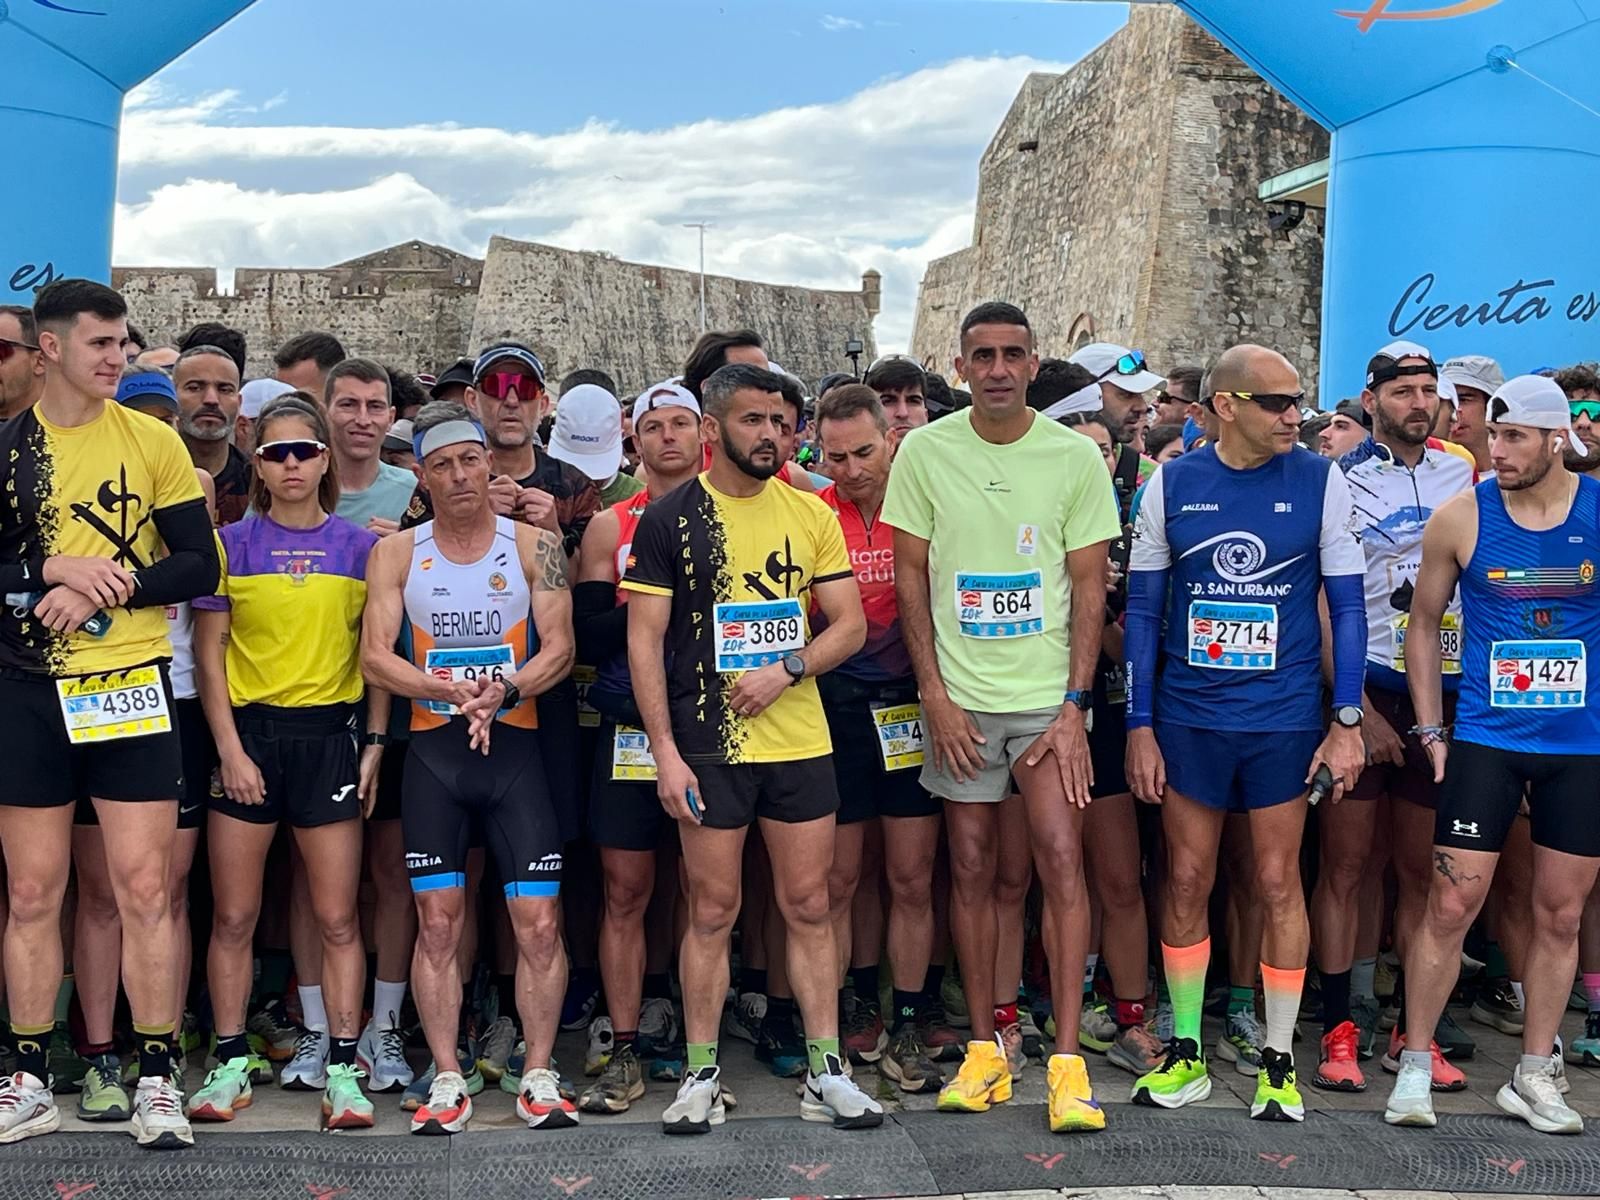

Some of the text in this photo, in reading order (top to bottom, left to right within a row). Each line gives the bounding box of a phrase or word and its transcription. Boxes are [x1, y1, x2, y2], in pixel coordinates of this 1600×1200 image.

[571, 434, 600, 442] BROOKS
[1181, 503, 1219, 512] BALEARIA
[1207, 583, 1235, 596] SAN
[992, 589, 1032, 614] 664
[431, 609, 502, 638] BERMEJO
[750, 618, 798, 645] 3869
[1216, 622, 1270, 645] 2714
[1525, 660, 1578, 682] 1427
[103, 687, 160, 715] 4389
